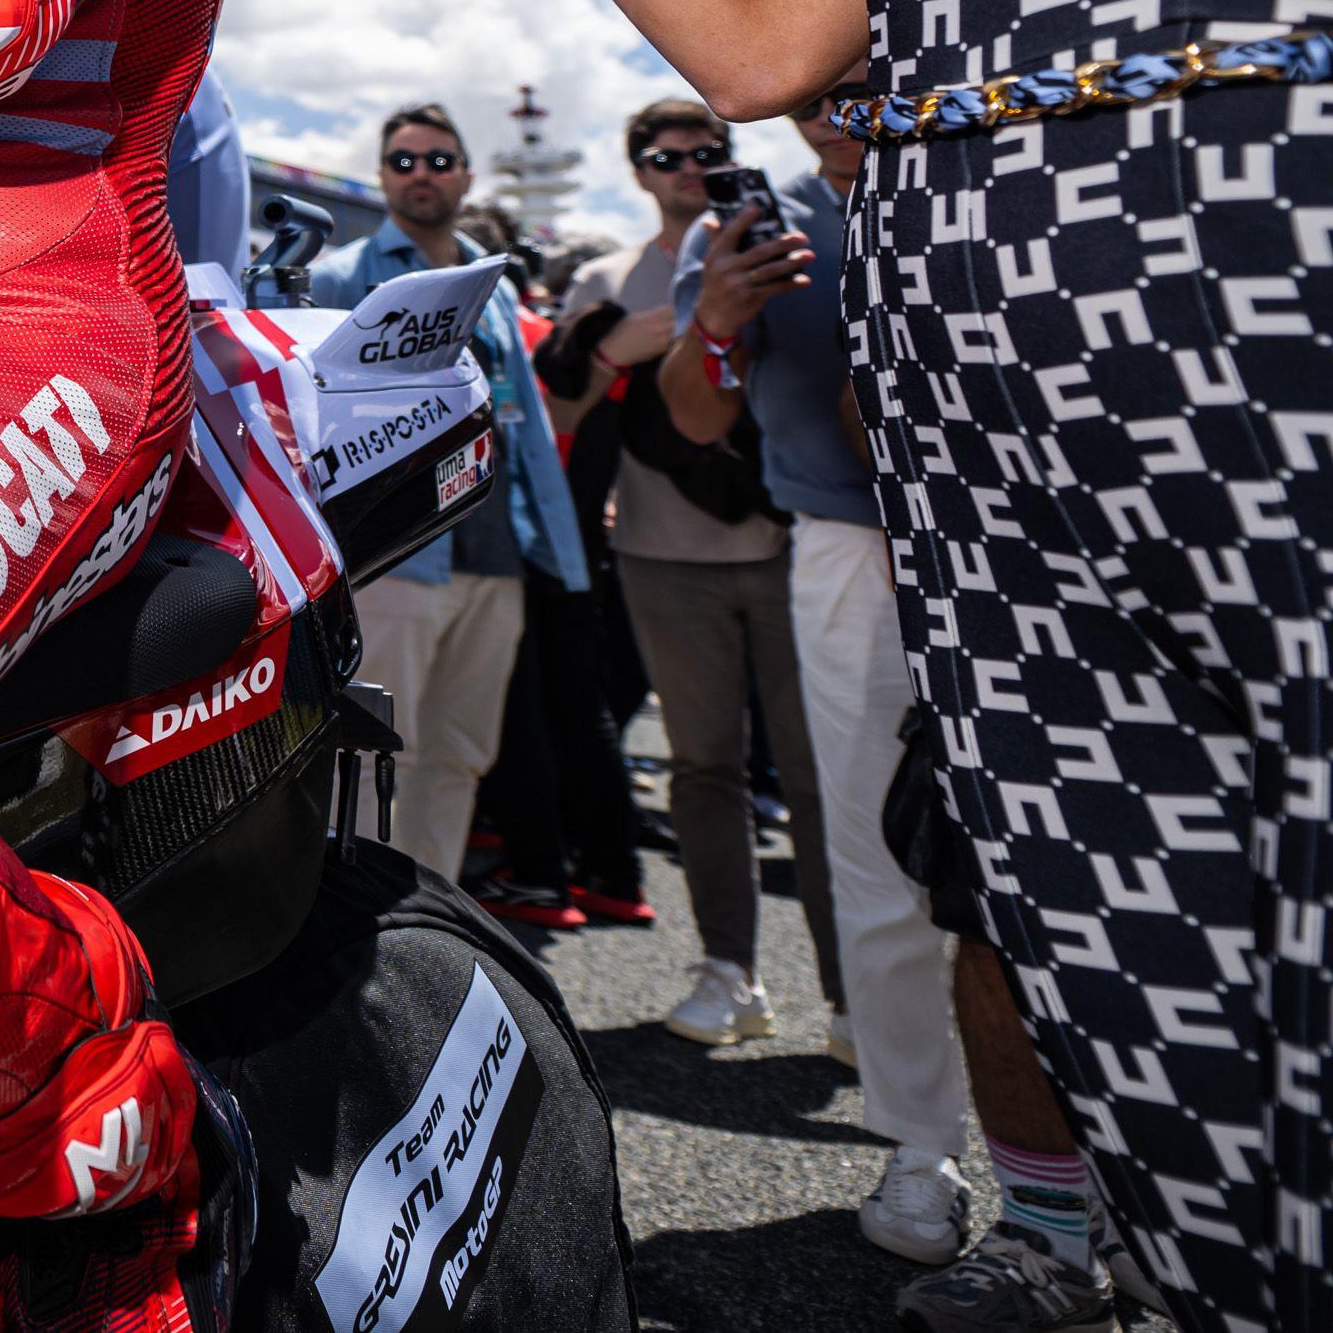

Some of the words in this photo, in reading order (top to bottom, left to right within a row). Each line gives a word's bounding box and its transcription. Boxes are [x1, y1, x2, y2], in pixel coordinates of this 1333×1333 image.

[359, 324, 465, 364] GLOBAL
[398, 307, 459, 338] AUS
[437, 450, 466, 484] uma
[440, 465, 476, 504] racing
[151, 657, 276, 745] DAIKO
[385, 1094, 445, 1178] Team
[352, 1165, 443, 1333] GRESINI
[444, 1017, 511, 1174] RACING
[439, 1155, 503, 1311] MotoGP
